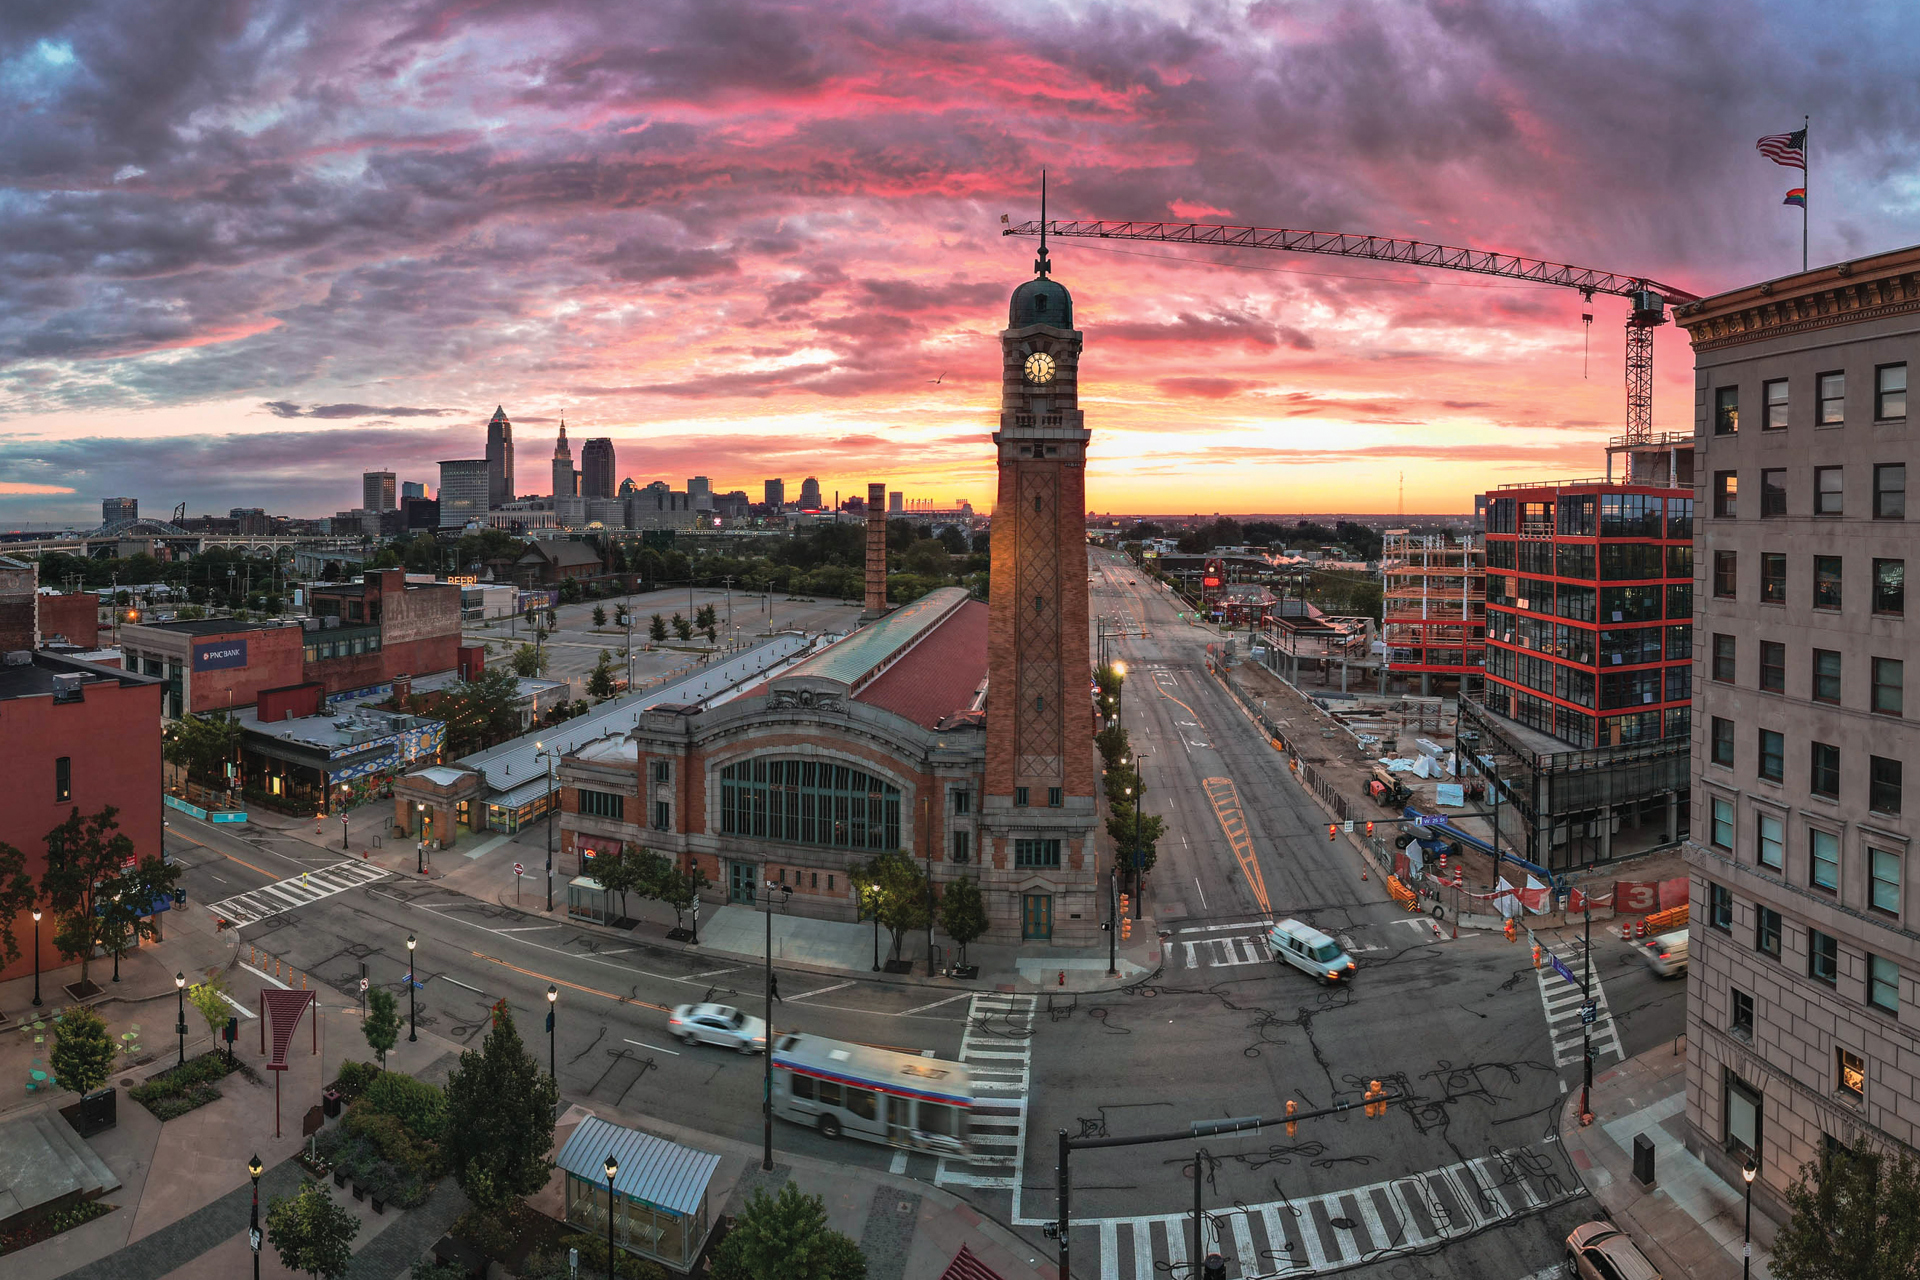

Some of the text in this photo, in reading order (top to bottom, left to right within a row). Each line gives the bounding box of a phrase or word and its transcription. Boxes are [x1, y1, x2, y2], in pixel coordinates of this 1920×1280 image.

[447, 574, 477, 587] BEER!
[209, 649, 240, 659] PNC BANK
[1628, 886, 1654, 909] 3
